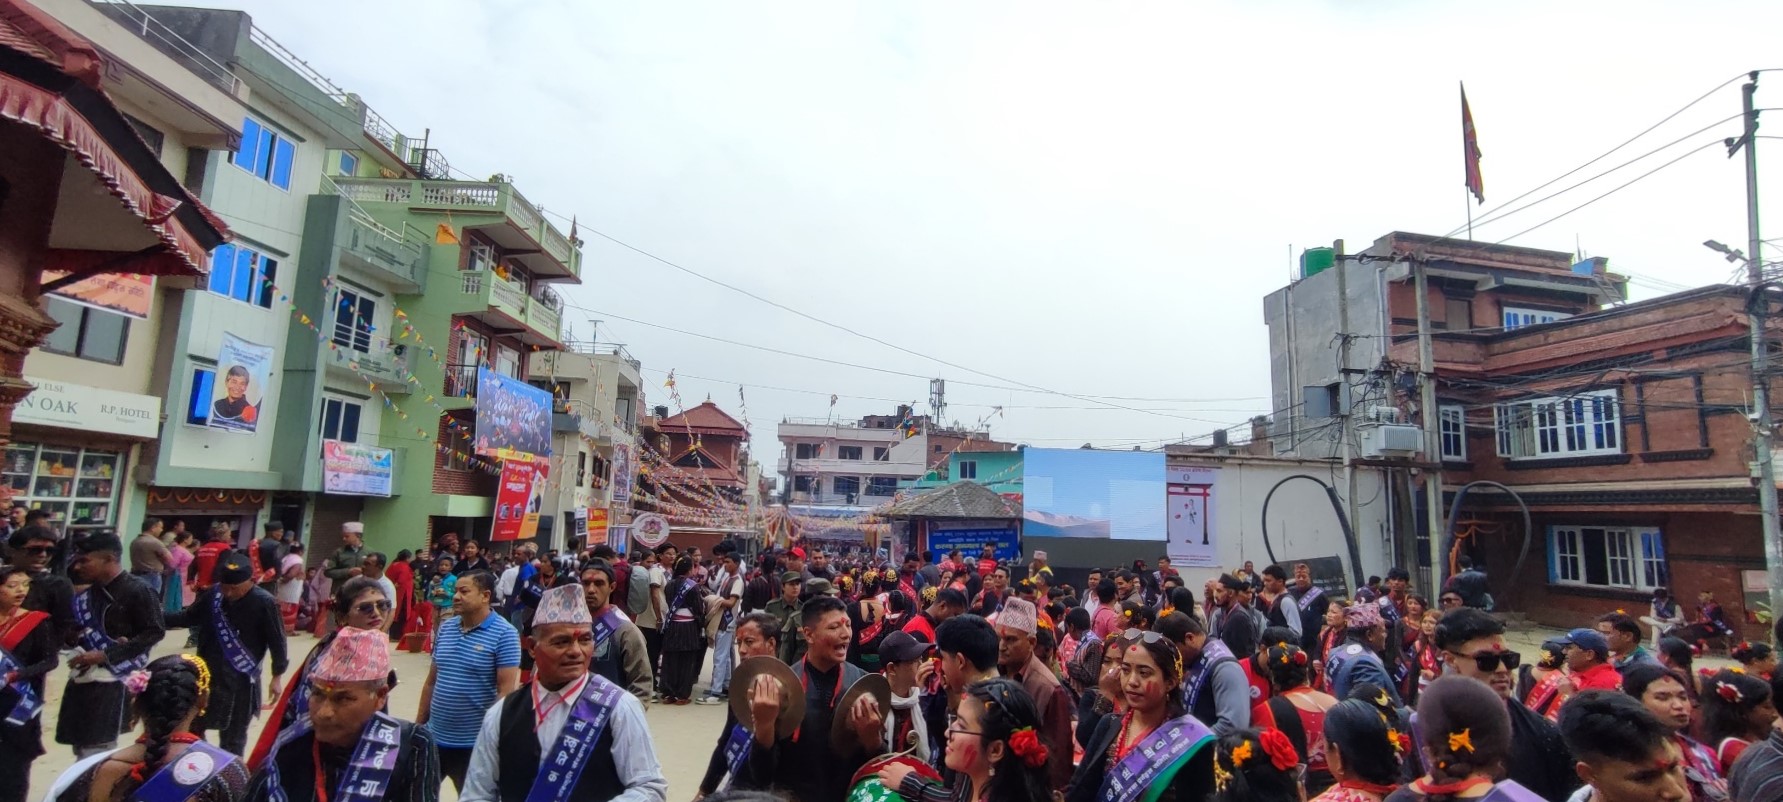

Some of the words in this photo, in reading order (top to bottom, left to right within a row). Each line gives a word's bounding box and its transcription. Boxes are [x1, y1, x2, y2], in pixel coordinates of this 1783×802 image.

[44, 384, 65, 393] ELSE
[40, 397, 78, 414] OAK
[100, 404, 118, 415] R.P.
[119, 406, 152, 420] HOTEL
